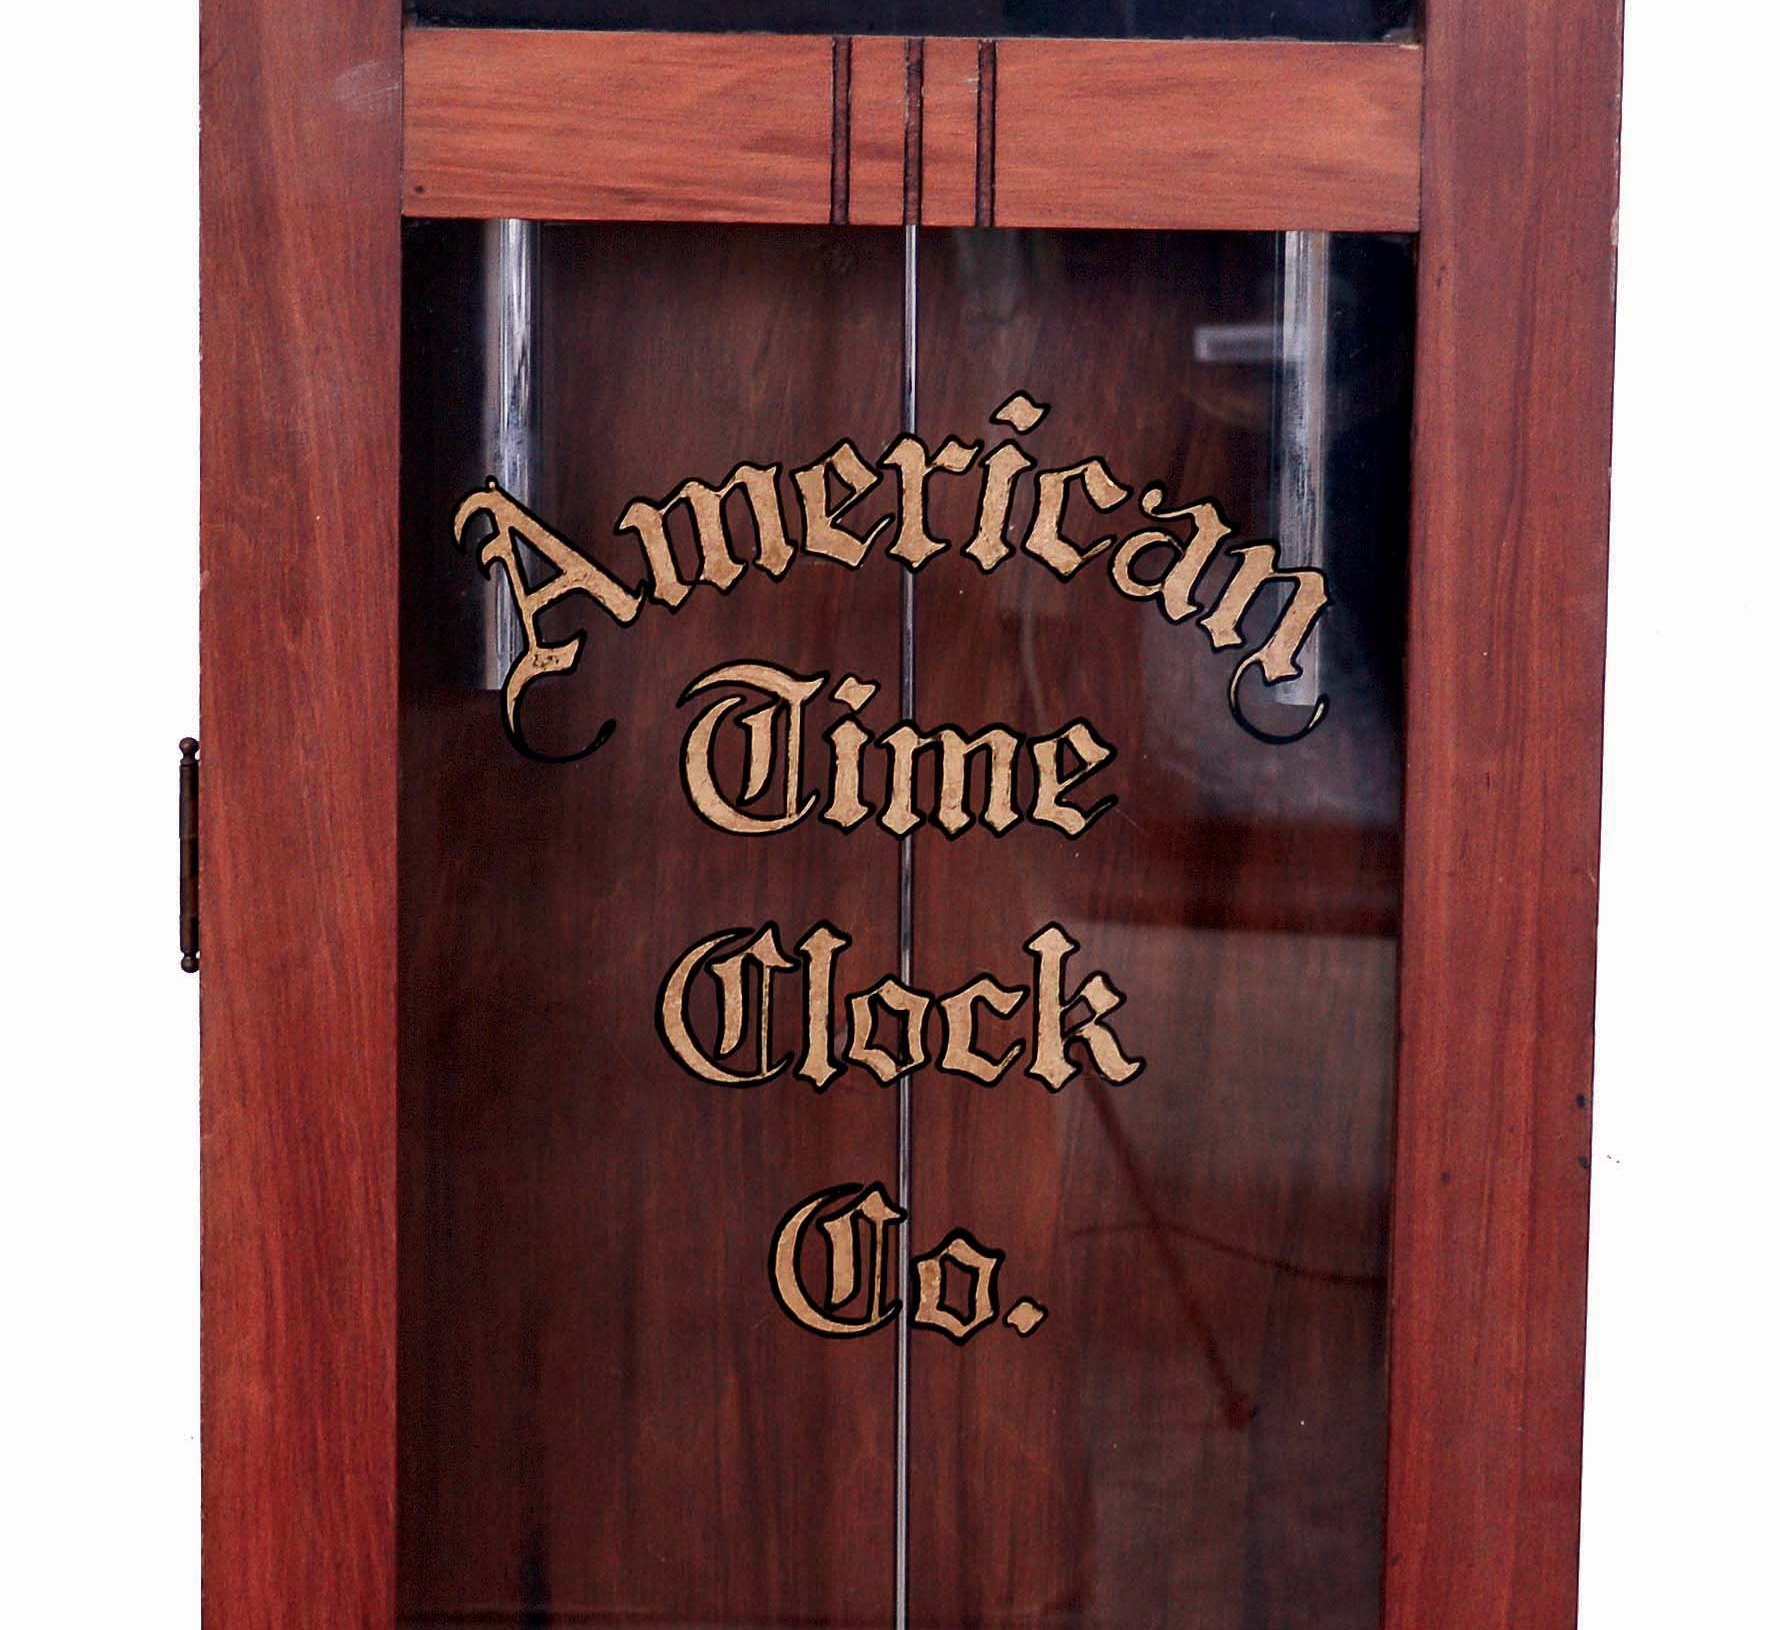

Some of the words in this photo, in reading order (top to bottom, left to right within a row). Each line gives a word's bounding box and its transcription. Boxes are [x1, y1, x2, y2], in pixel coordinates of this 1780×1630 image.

[453, 391, 1334, 762] American
[678, 659, 1118, 839] Time
[655, 920, 1146, 1092] Clock
[767, 1181, 1049, 1344] Co.
